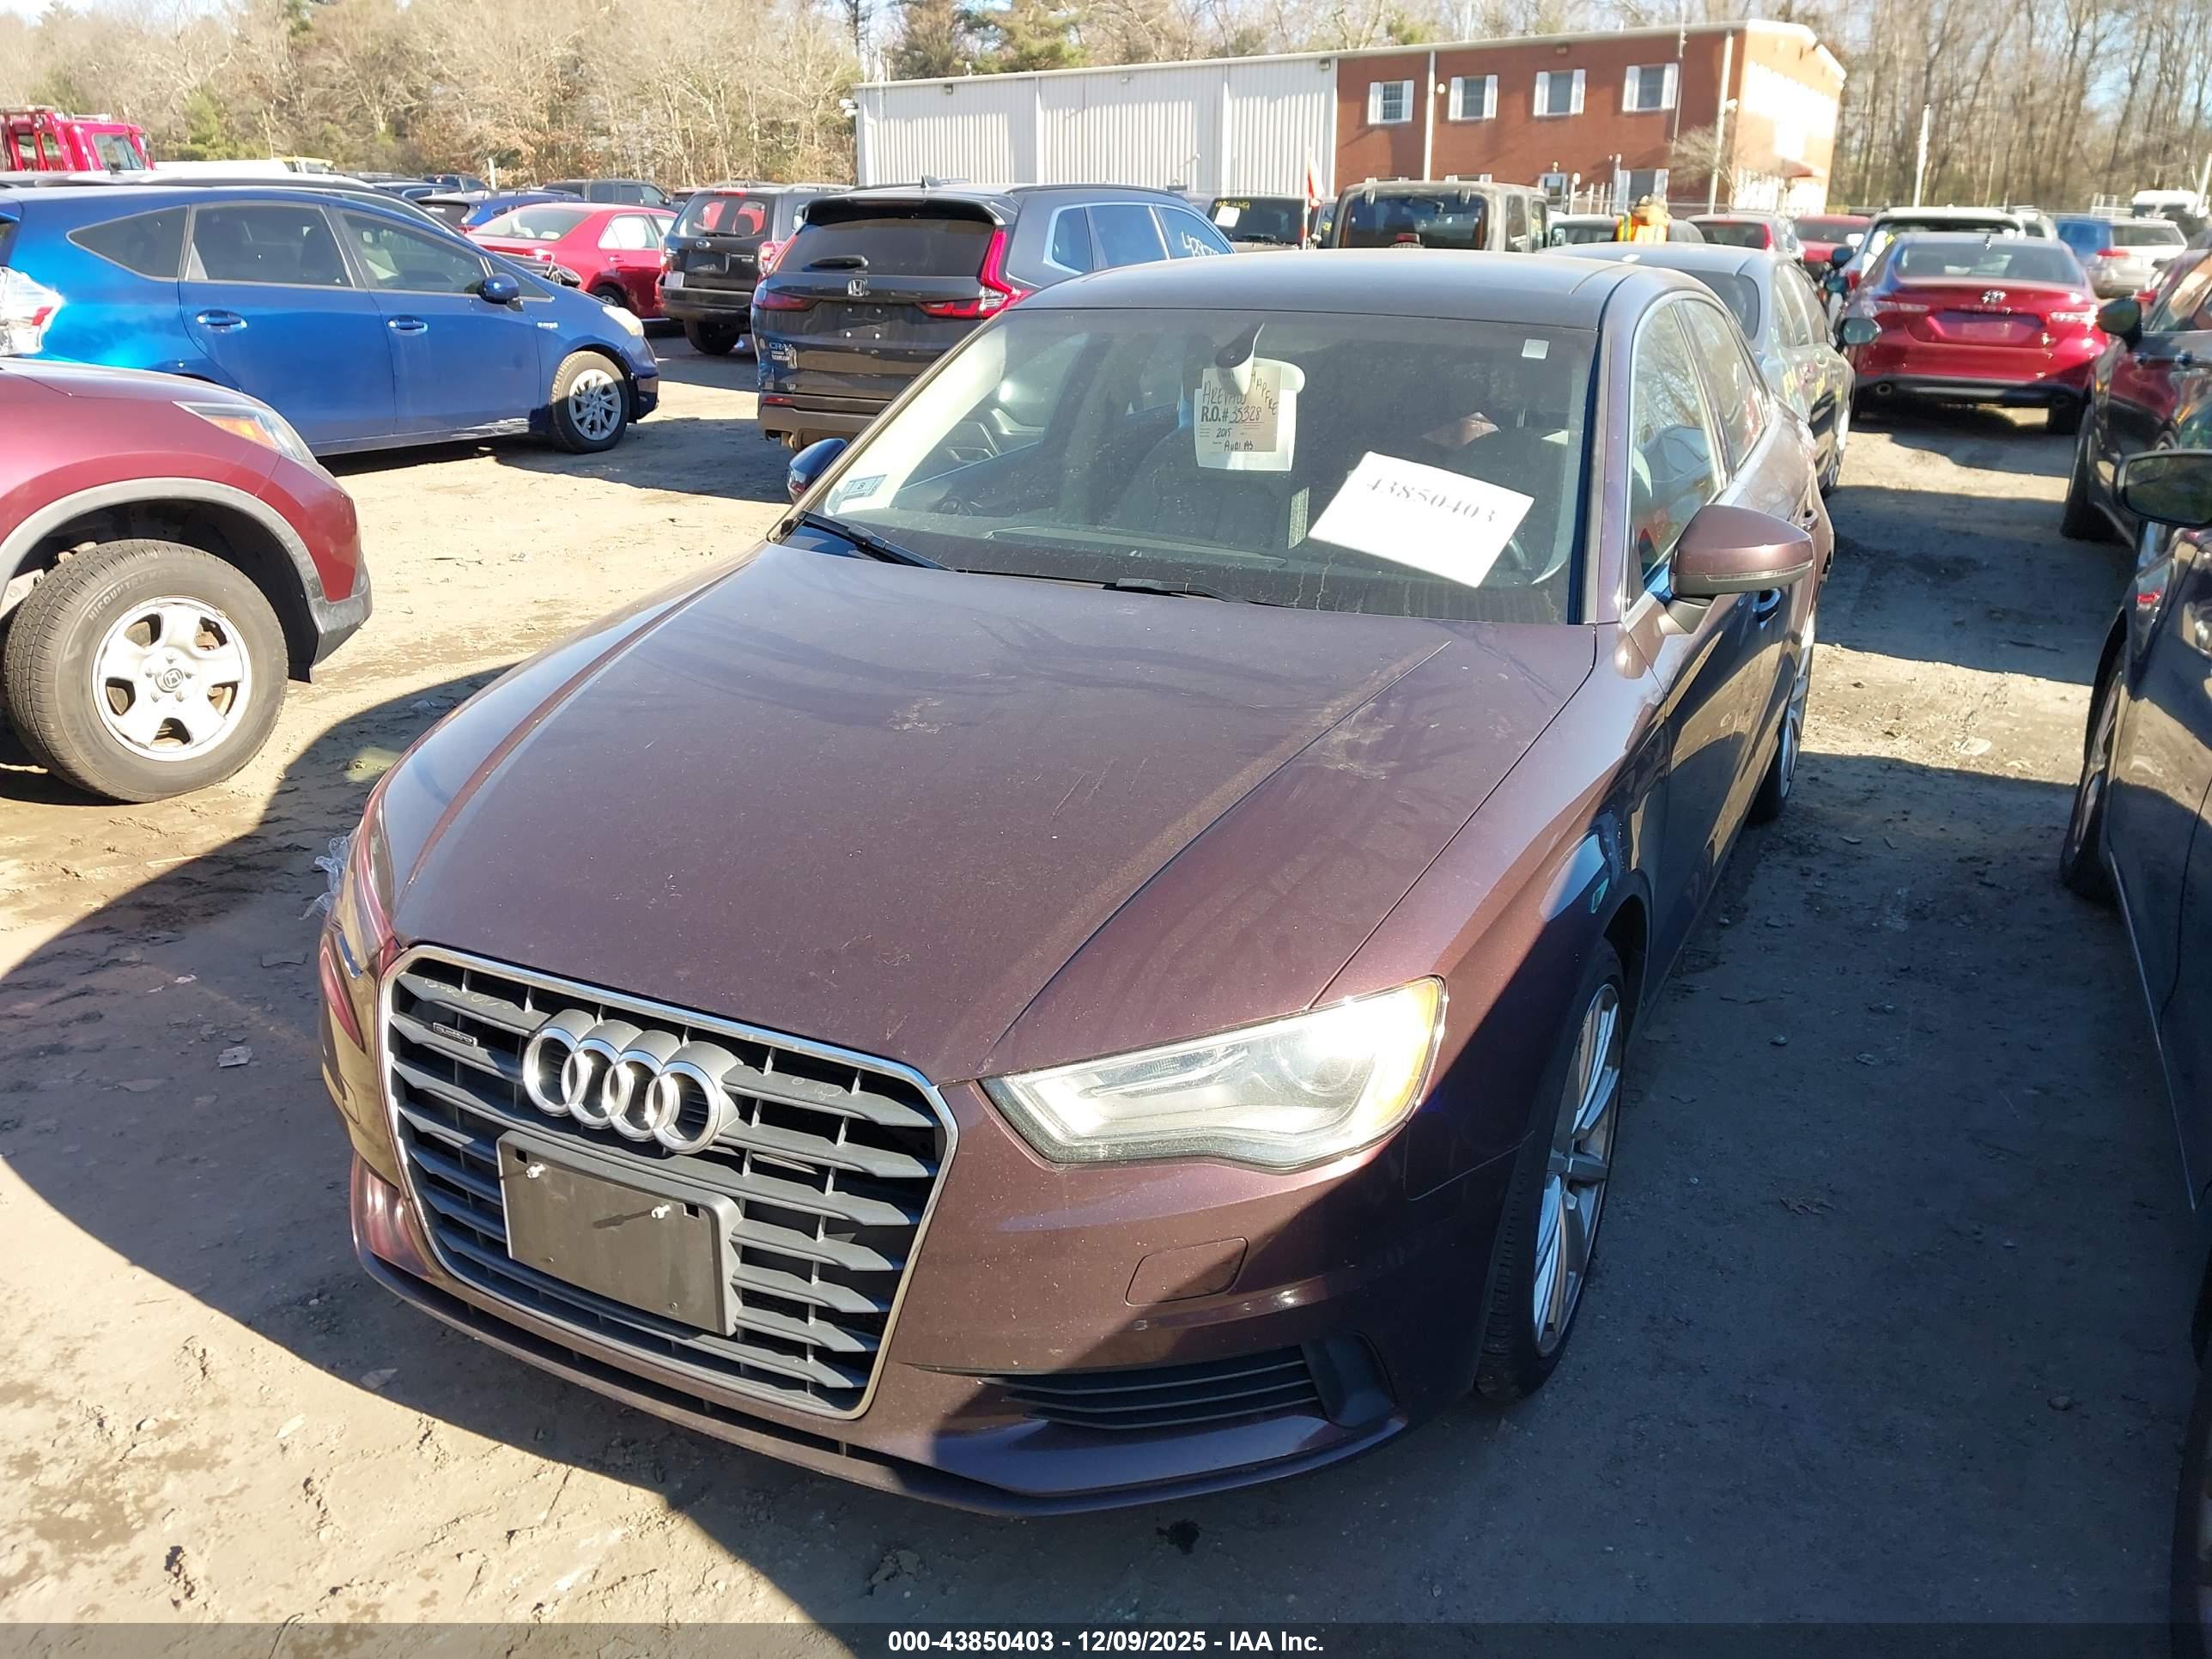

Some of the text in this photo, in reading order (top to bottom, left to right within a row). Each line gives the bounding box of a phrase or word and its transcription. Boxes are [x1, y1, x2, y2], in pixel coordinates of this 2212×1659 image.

[769, 342, 793, 352] CR-V
[1229, 405, 1262, 423] 35328
[1216, 428, 1231, 438] 2015
[1366, 478, 1496, 522] 43850403
